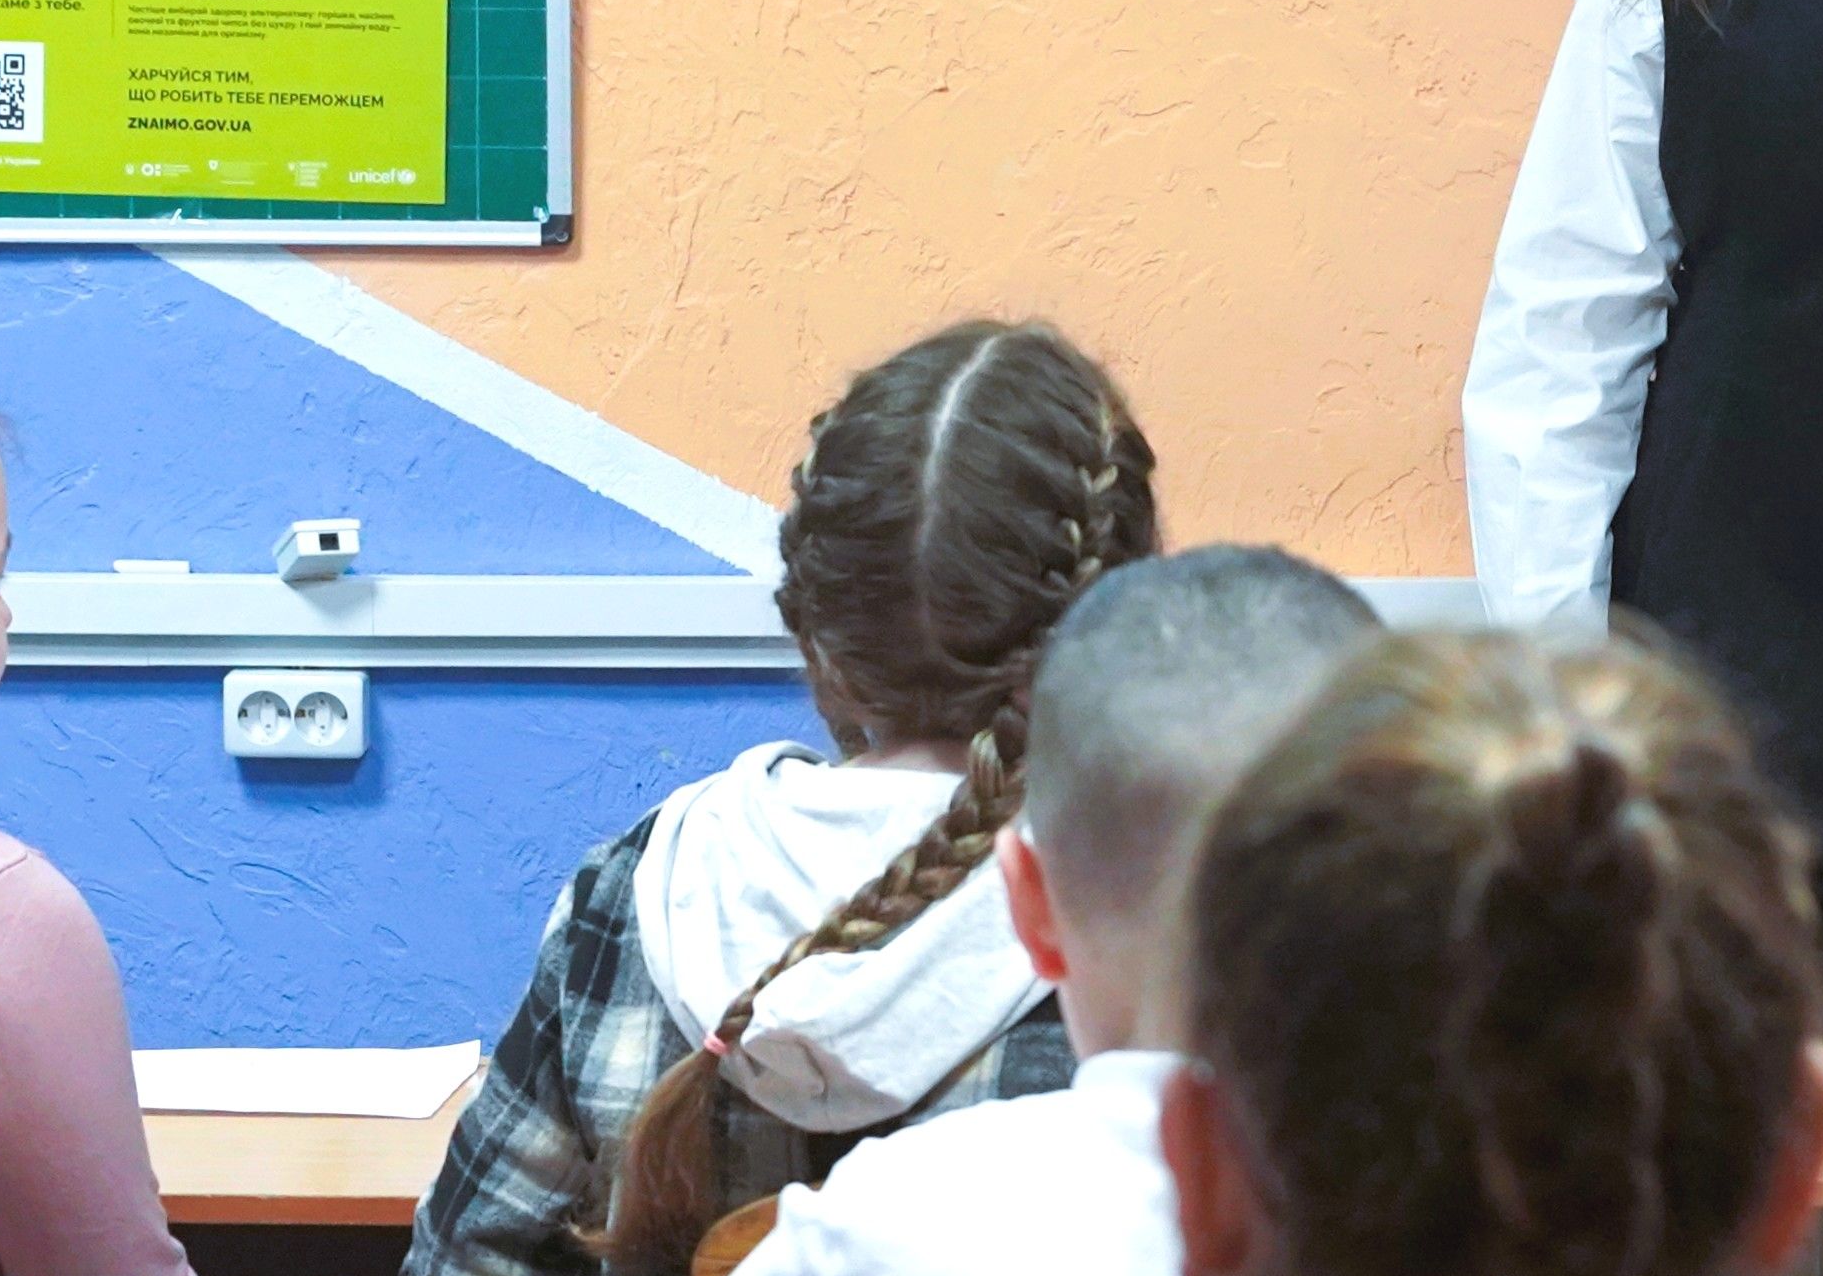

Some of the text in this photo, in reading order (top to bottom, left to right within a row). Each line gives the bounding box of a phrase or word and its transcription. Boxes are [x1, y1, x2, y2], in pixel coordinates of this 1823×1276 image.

[35, 0, 41, 9] з
[128, 66, 252, 84] ХАРЧУЙСЯ ТИМ,
[128, 89, 383, 108] ЩО РОБИТЬ ТЕБЕ ПЕРЕМОЖЦЕМ
[128, 117, 250, 131] ZNAIMO.GOV.UA
[349, 168, 398, 183] unicef
